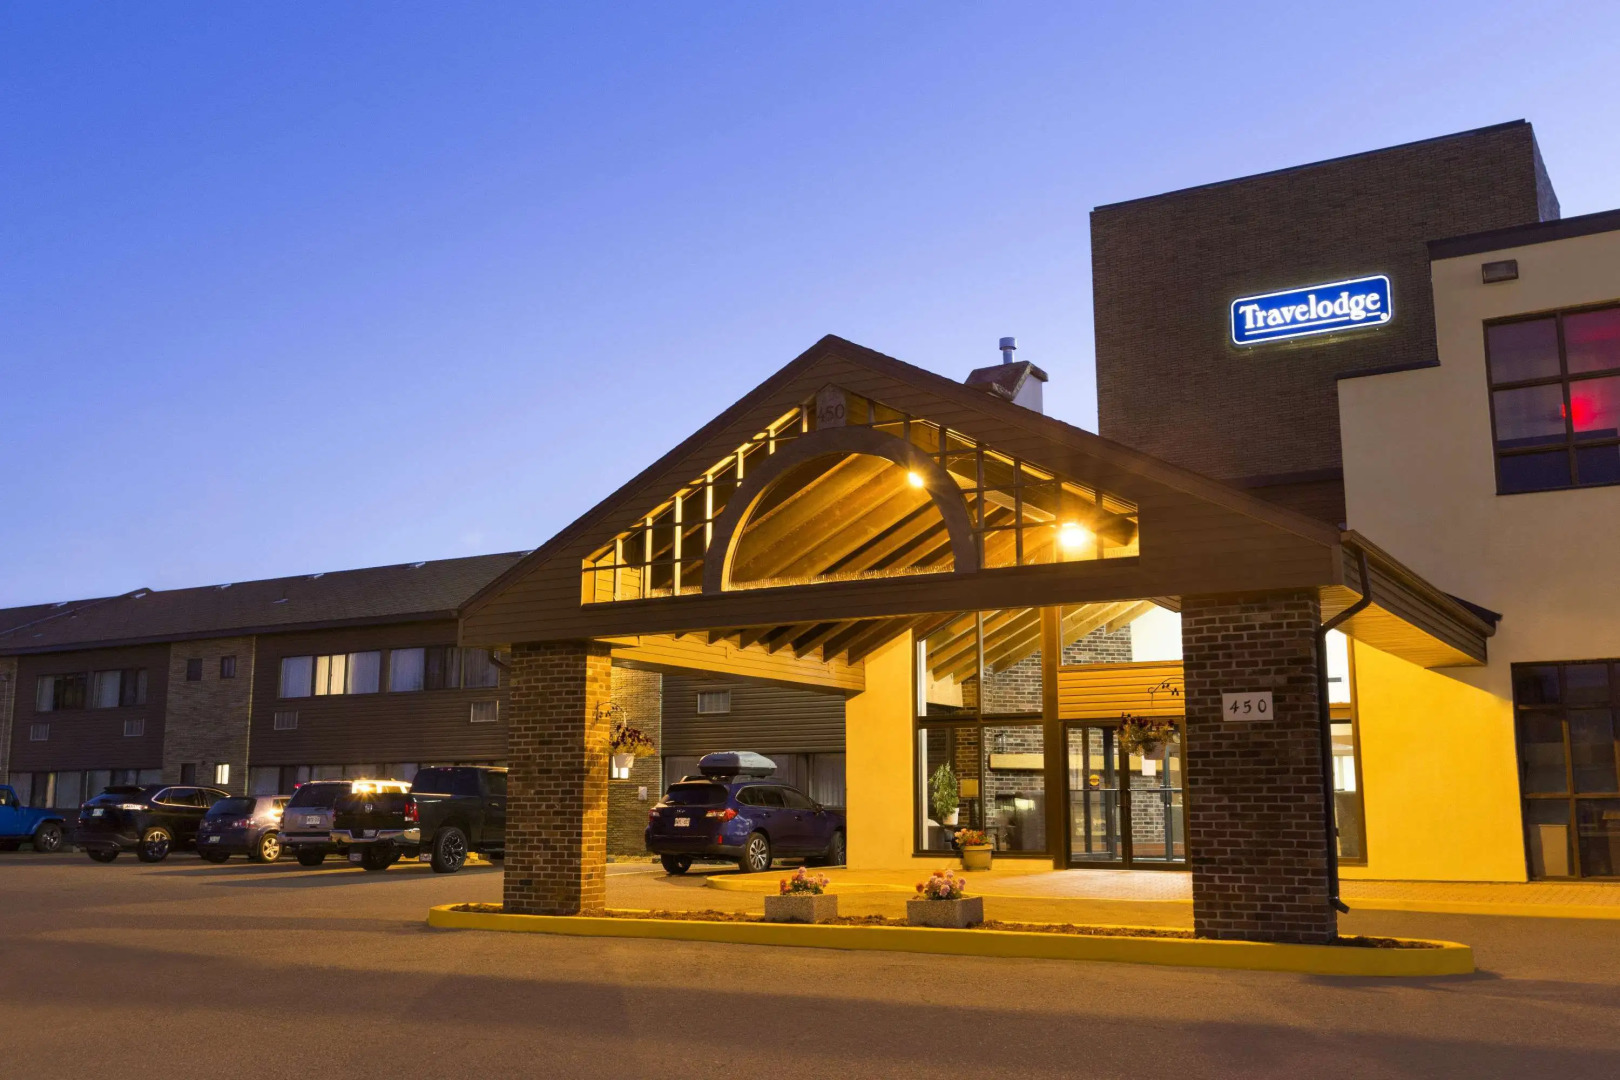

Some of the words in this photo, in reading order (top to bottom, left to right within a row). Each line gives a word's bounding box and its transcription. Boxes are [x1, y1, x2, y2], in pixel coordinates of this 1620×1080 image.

[1238, 291, 1381, 329] Travelodge
[817, 403, 845, 422] 450
[1229, 698, 1267, 714] 450
